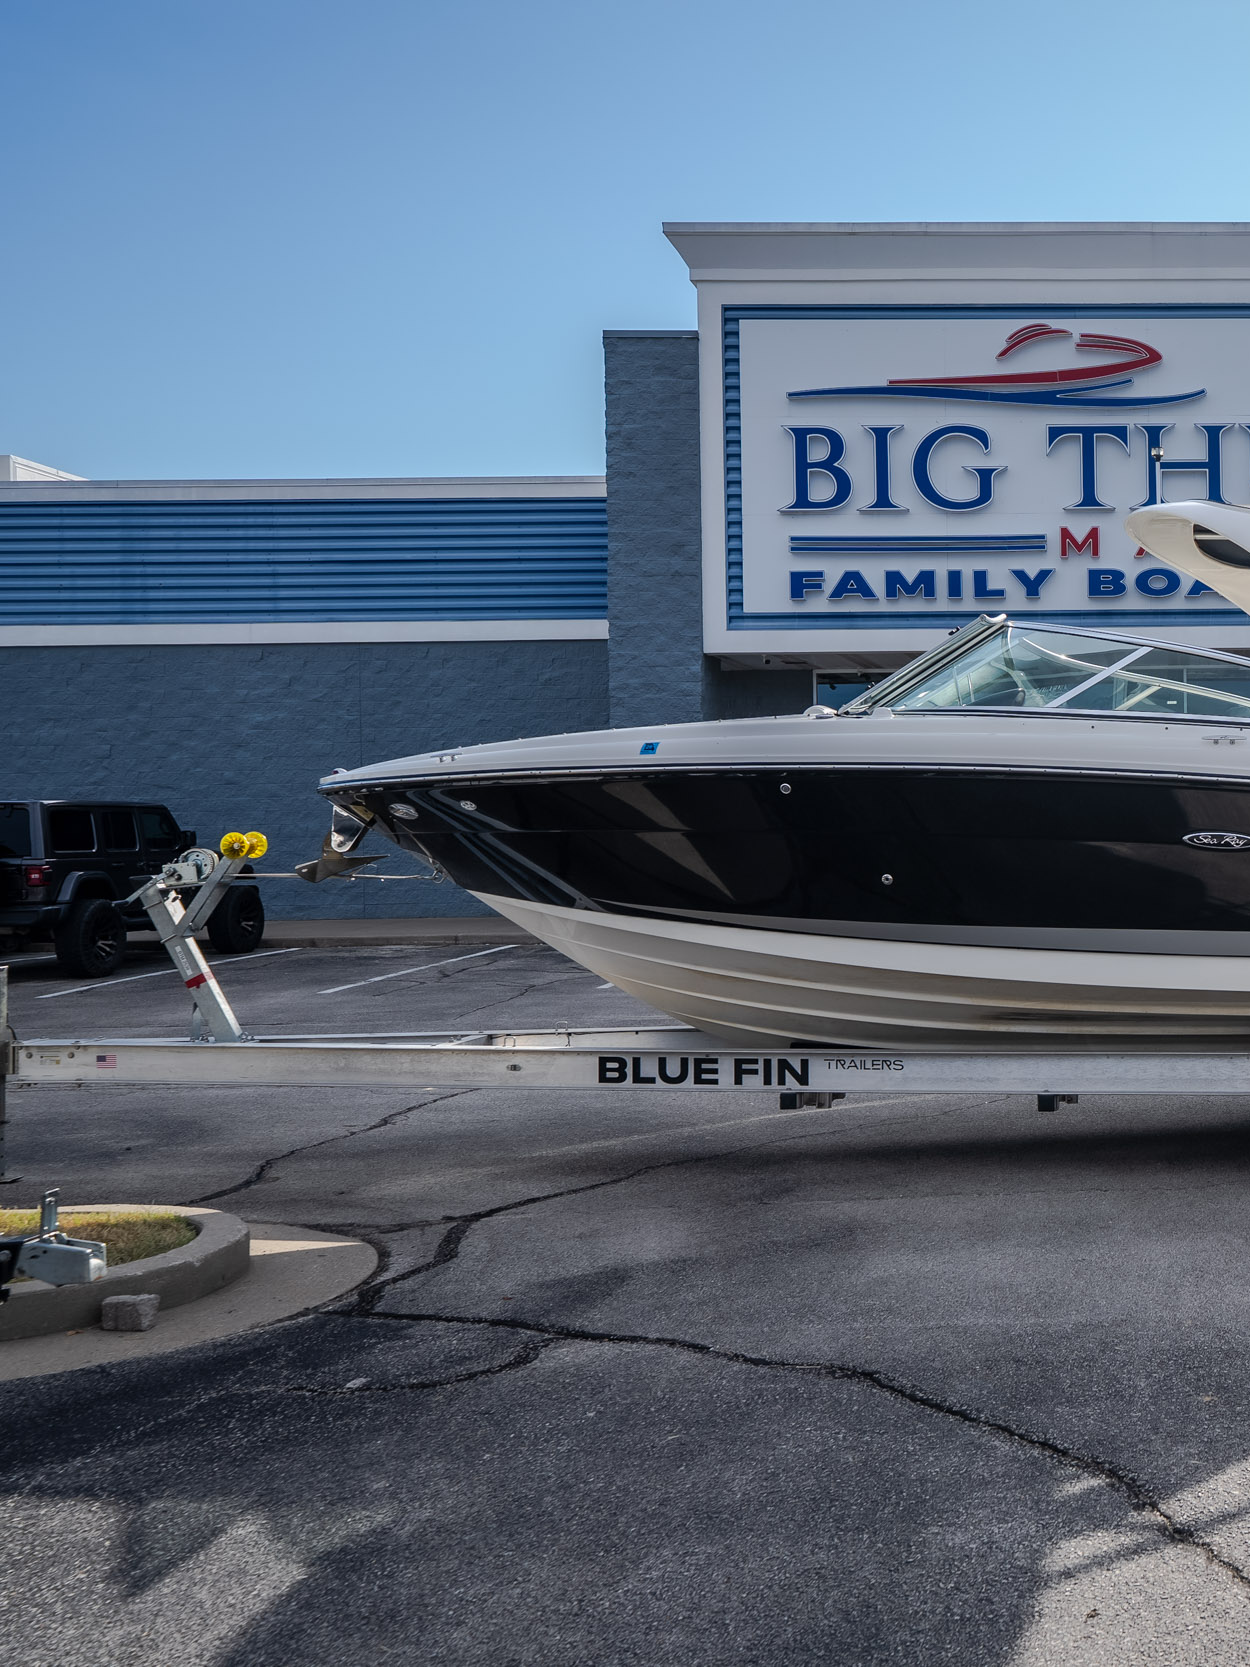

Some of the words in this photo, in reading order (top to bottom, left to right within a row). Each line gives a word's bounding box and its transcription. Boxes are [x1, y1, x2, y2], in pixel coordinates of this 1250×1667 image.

[777, 423, 1008, 513] BIG
[788, 567, 1057, 600] FAMILY
[1194, 834, 1218, 845] Sea
[1221, 835, 1248, 848] Ray
[598, 1056, 719, 1085] BLUE
[734, 1057, 810, 1086] FIN
[823, 1058, 905, 1071] TRAILERS
